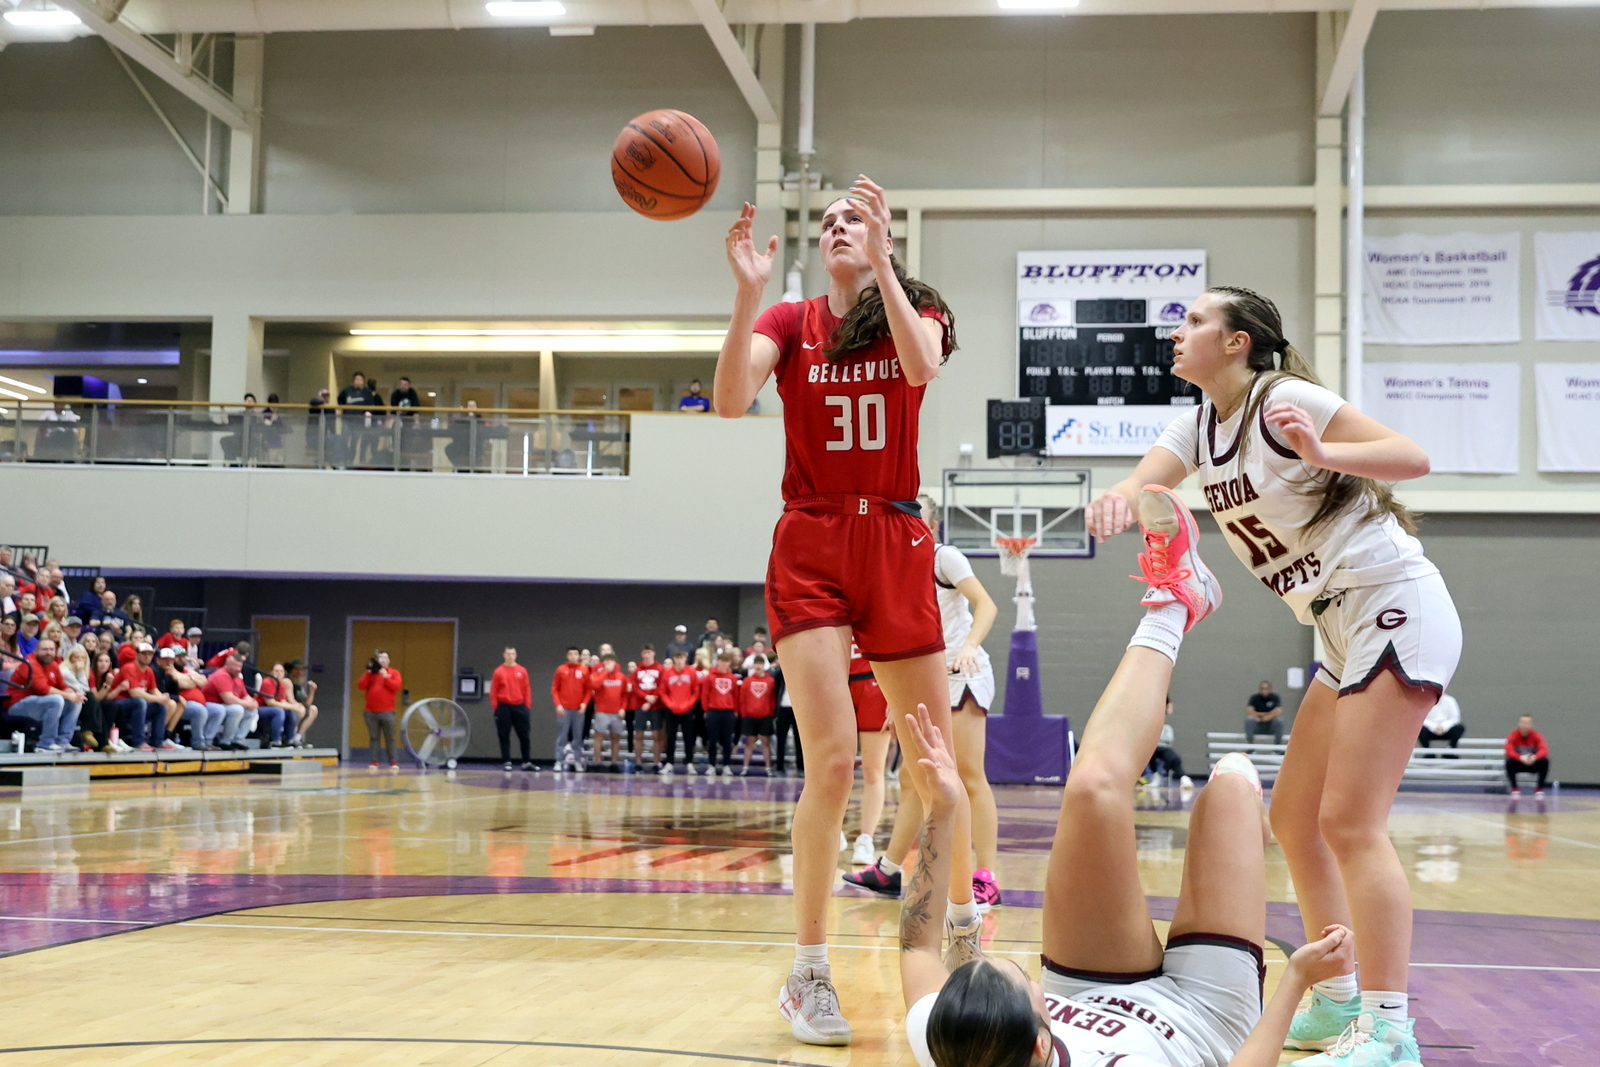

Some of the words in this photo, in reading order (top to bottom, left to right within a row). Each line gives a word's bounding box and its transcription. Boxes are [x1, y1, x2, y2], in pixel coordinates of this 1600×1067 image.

[1368, 251, 1430, 263] Women's
[1435, 250, 1507, 263] Basketball
[1020, 263, 1202, 278] BLUFFTON
[1022, 327, 1077, 340] BLUFFTON
[1096, 333, 1125, 342] PERIOD
[807, 357, 900, 383] BELLEVUE
[1026, 366, 1051, 376] FOULS
[1084, 366, 1114, 376] PLAYER
[1383, 377, 1443, 388] Women's
[1447, 376, 1490, 388] Tennis
[1565, 377, 1600, 388] Wom
[1096, 397, 1125, 406] MATCH
[1171, 397, 1195, 406] SCORE
[824, 393, 887, 451] 30
[1203, 472, 1260, 513] GENOA
[858, 498, 868, 515] B
[1224, 513, 1290, 570] 15
[1260, 551, 1321, 597] METS
[1374, 606, 1410, 631] G
[1044, 997, 1126, 1038] GENO
